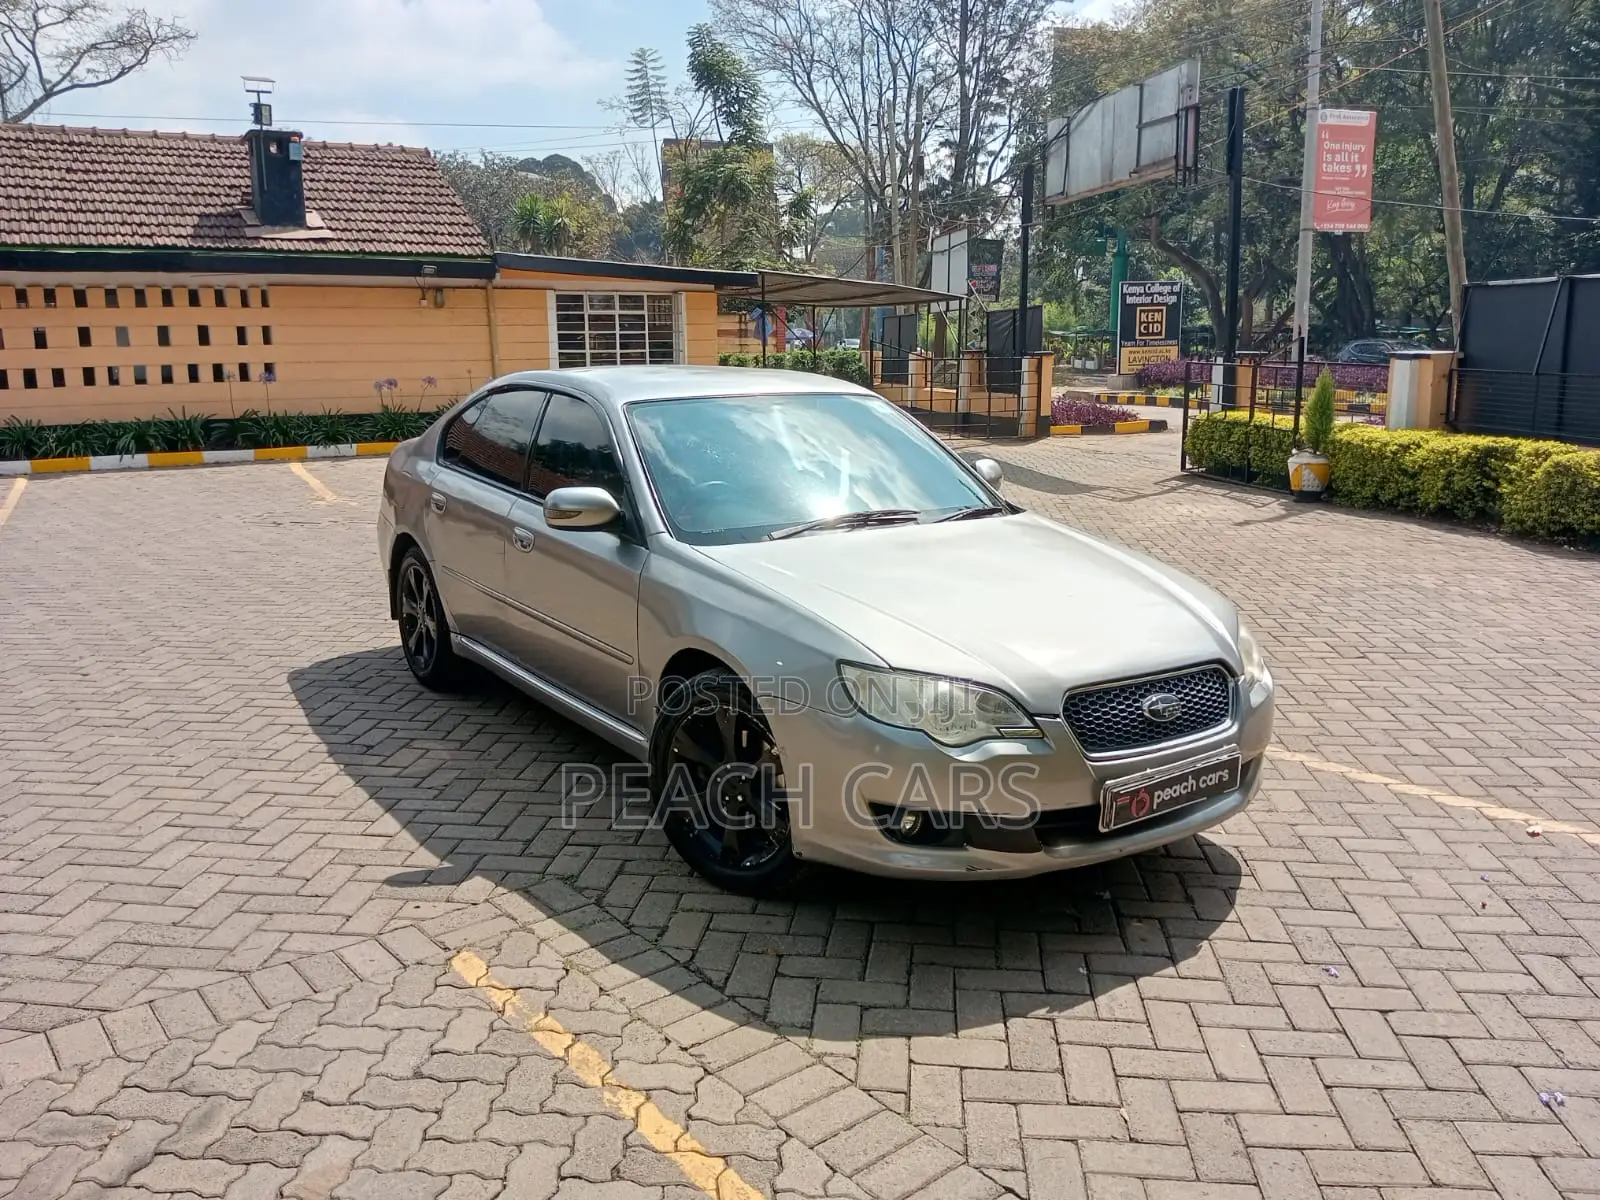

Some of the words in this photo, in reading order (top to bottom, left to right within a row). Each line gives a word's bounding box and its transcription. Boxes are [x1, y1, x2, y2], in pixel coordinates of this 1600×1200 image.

[1323, 141, 1340, 150] One
[1341, 141, 1366, 152] injury
[1334, 151, 1348, 162] all
[1350, 151, 1359, 163] it
[1322, 162, 1352, 173] takes
[1123, 284, 1144, 295] Kenya
[1145, 283, 1171, 294] College
[1173, 283, 1181, 292] of
[1126, 295, 1152, 304] Interior
[1153, 294, 1177, 305] Design
[1140, 312, 1162, 322] KEN
[1140, 323, 1162, 333] CID
[1128, 354, 1172, 363] LAVINGTON
[1153, 775, 1197, 809] peach
[1199, 769, 1229, 788] cars
